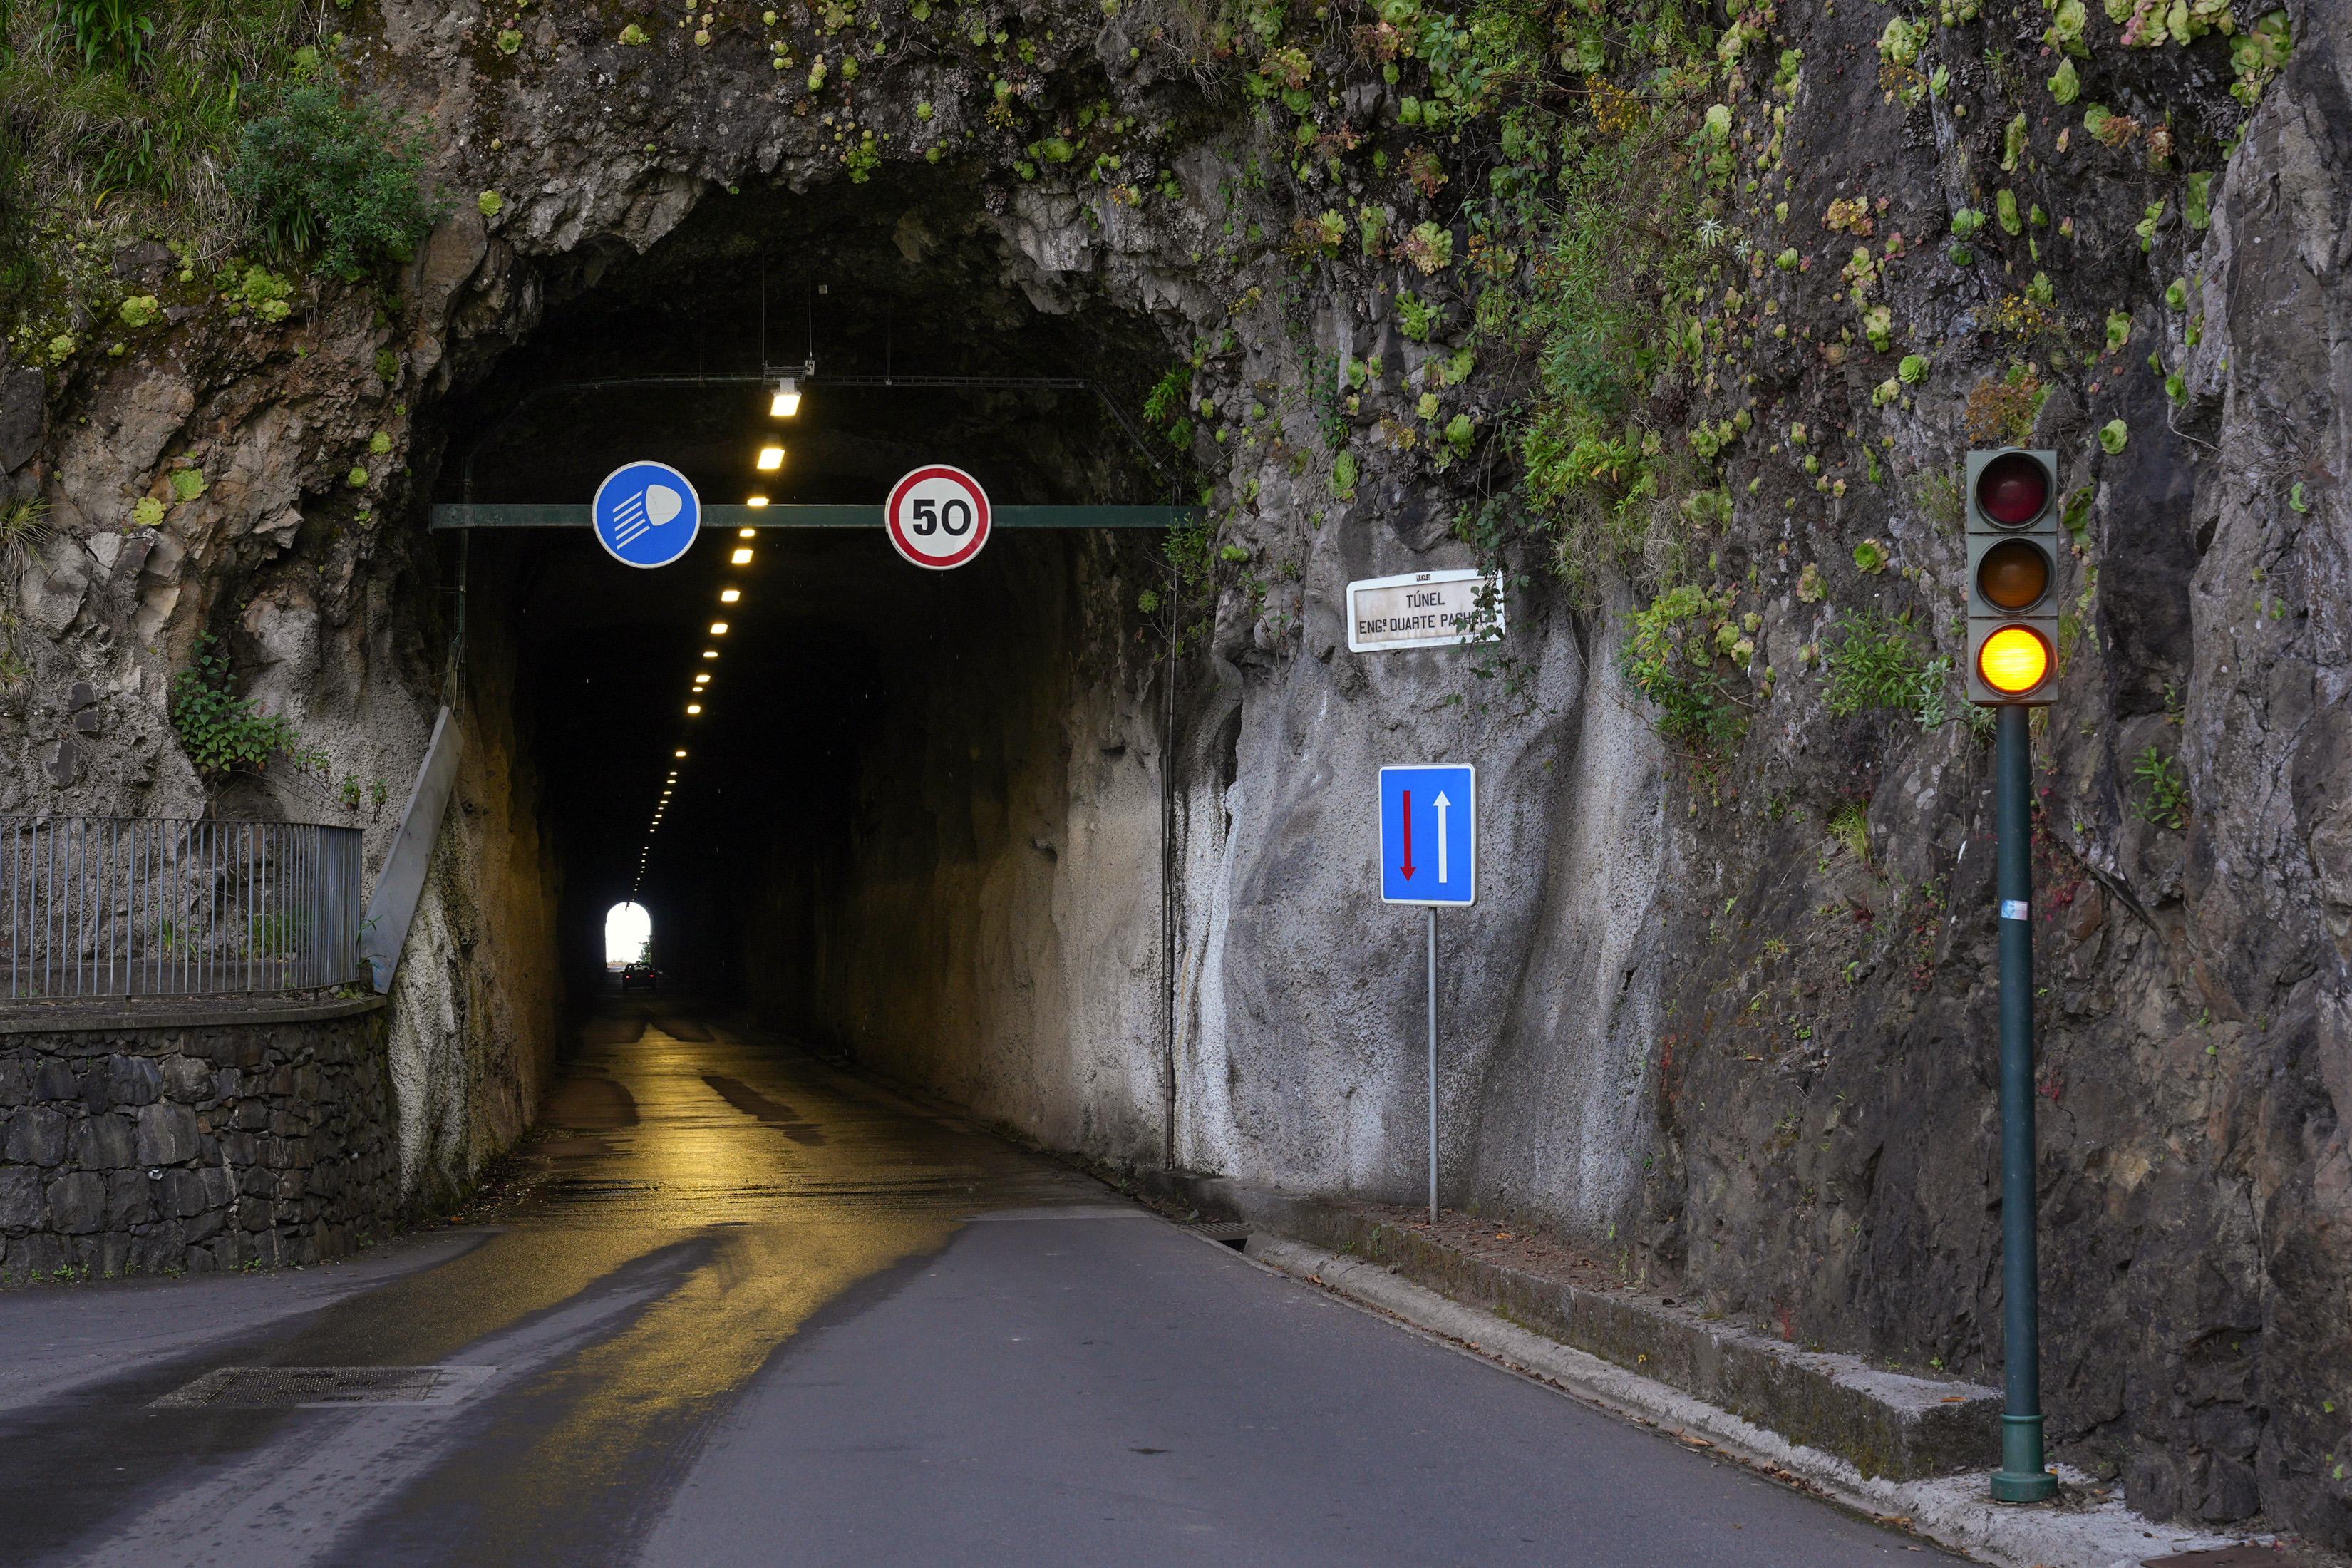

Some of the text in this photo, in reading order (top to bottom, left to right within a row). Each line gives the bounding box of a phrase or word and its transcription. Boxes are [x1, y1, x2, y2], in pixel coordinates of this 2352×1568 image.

[912, 499, 971, 536] 50
[1406, 589, 1445, 608] TÚNEL
[1390, 614, 1435, 631] DUARTE
